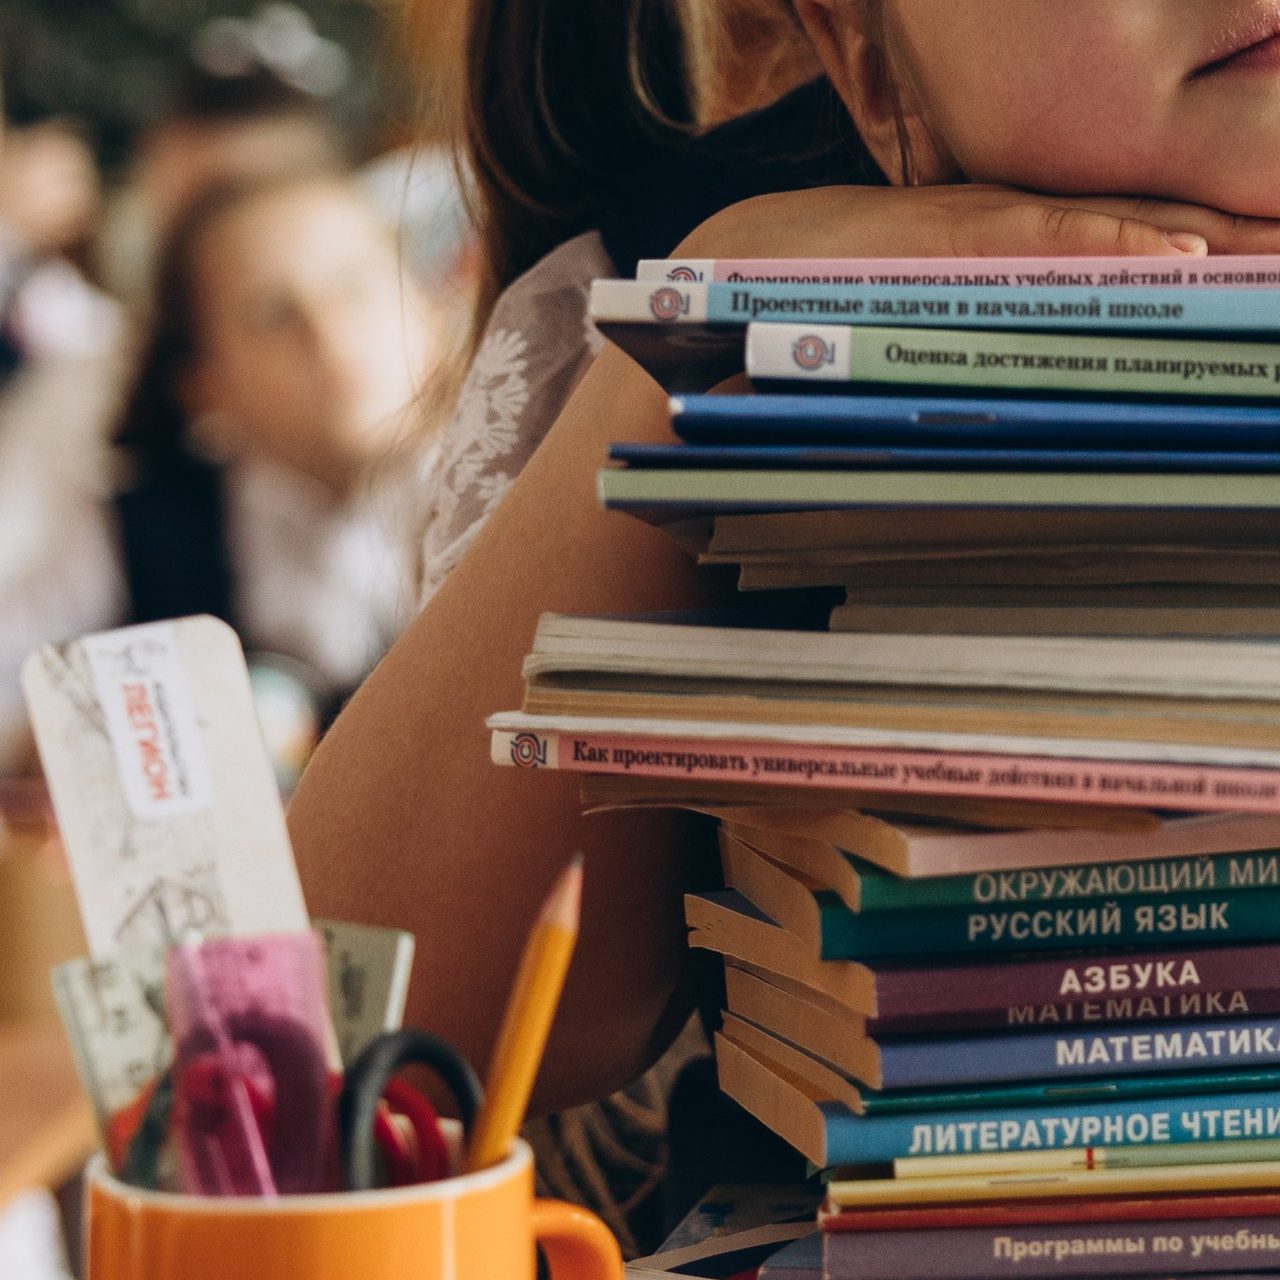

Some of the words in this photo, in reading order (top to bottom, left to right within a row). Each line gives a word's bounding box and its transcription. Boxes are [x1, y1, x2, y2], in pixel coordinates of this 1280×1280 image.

[868, 272, 1010, 287] универсальных
[1015, 270, 1094, 287] учебных
[1098, 268, 1183, 288] действий
[1188, 271, 1198, 284] в
[731, 290, 864, 317] Проектные
[870, 298, 950, 318] задачи
[955, 301, 969, 316] в
[975, 297, 1102, 318] начальной
[1107, 302, 1185, 318] школе
[884, 342, 969, 367] Оценка
[972, 349, 1108, 373] достижения
[1112, 356, 1268, 380] планируемых
[572, 739, 608, 763] Как
[612, 744, 748, 773] проектировать
[751, 756, 899, 781] универсальные
[902, 761, 982, 788] учебные
[972, 854, 1217, 903] ОКРУЖАЮЩИЙ
[966, 900, 1121, 941] РУССКИЙ
[1134, 901, 1230, 933] ЯЗЫК
[1059, 959, 1201, 996] АЗБУКА
[909, 1112, 1170, 1155] ЛИТЕРАТУРНОЕ
[993, 1235, 1146, 1262] Программы
[1153, 1235, 1183, 1253] по
